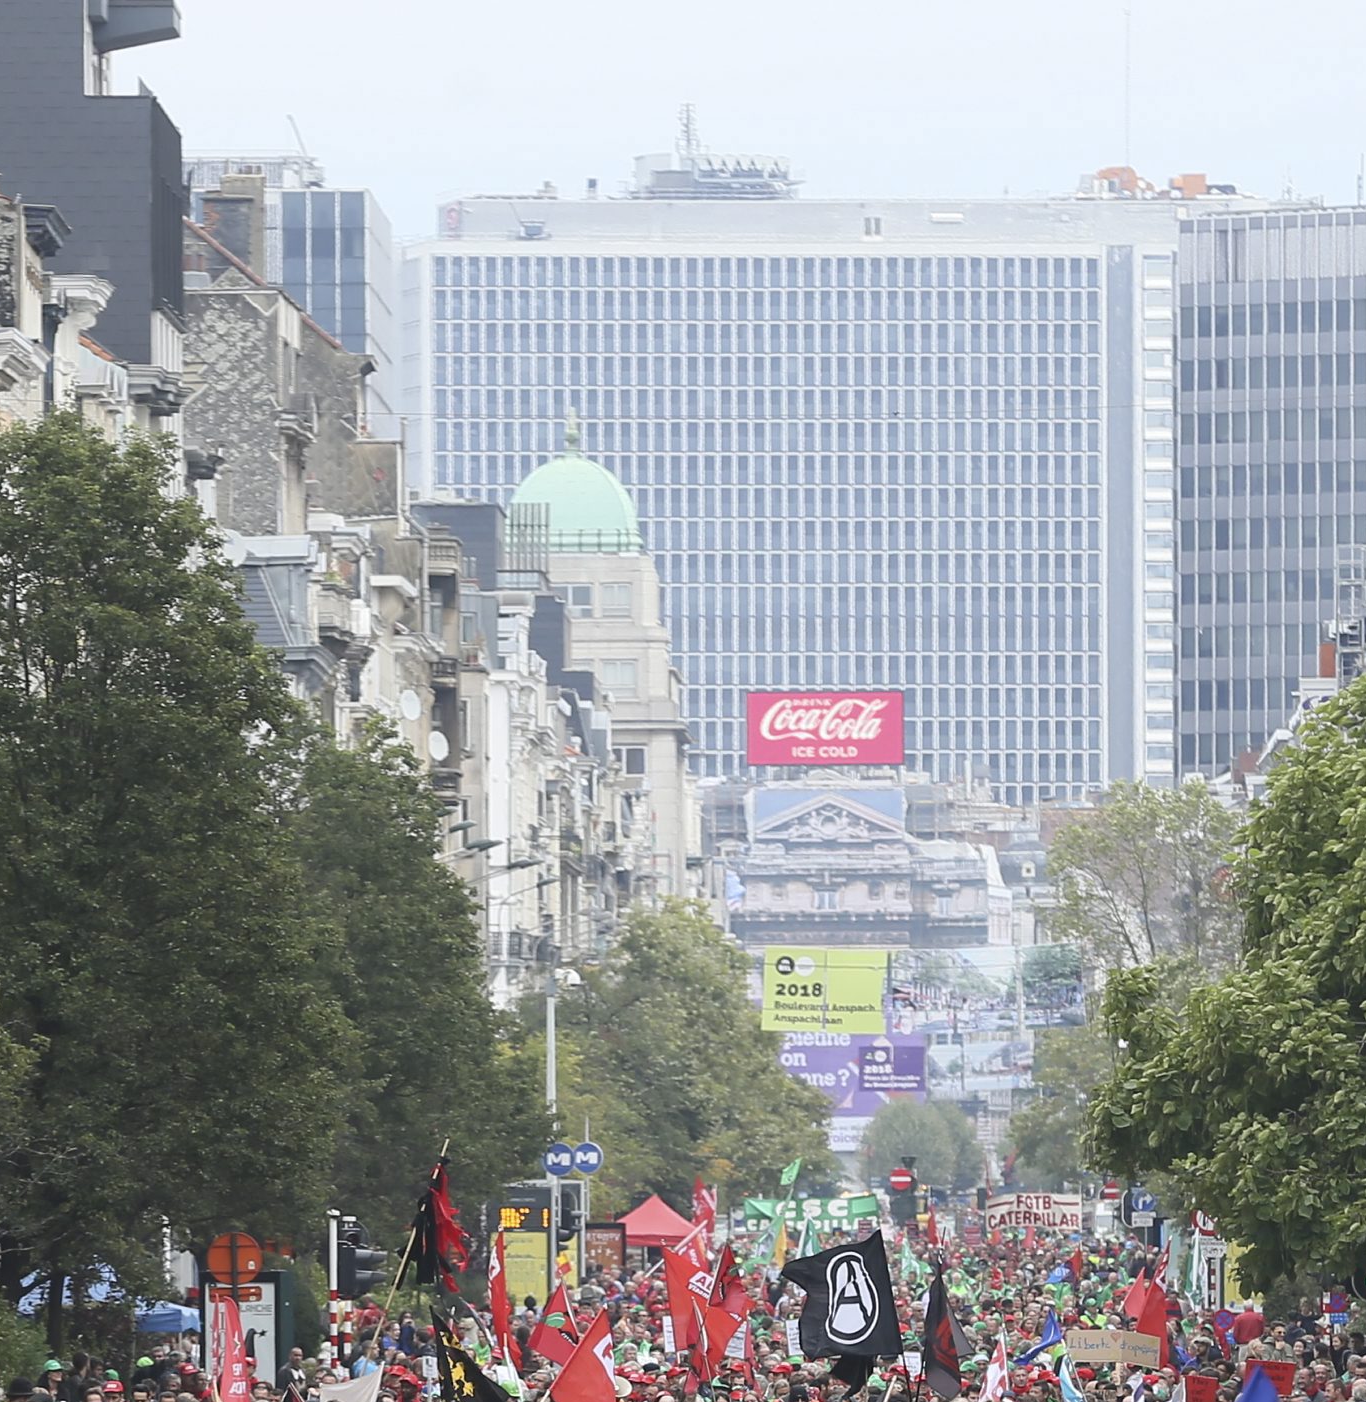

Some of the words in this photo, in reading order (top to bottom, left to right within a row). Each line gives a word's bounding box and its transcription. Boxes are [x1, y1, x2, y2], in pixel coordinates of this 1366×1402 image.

[759, 699, 889, 741] Coca-Cola
[792, 747, 815, 758] ICE
[819, 746, 858, 758] COLD
[775, 983, 823, 997] 2018
[832, 1004, 876, 1014] Anspach
[1016, 1195, 1052, 1210] FGTB
[988, 1210, 1080, 1230] CATERPILLAR
